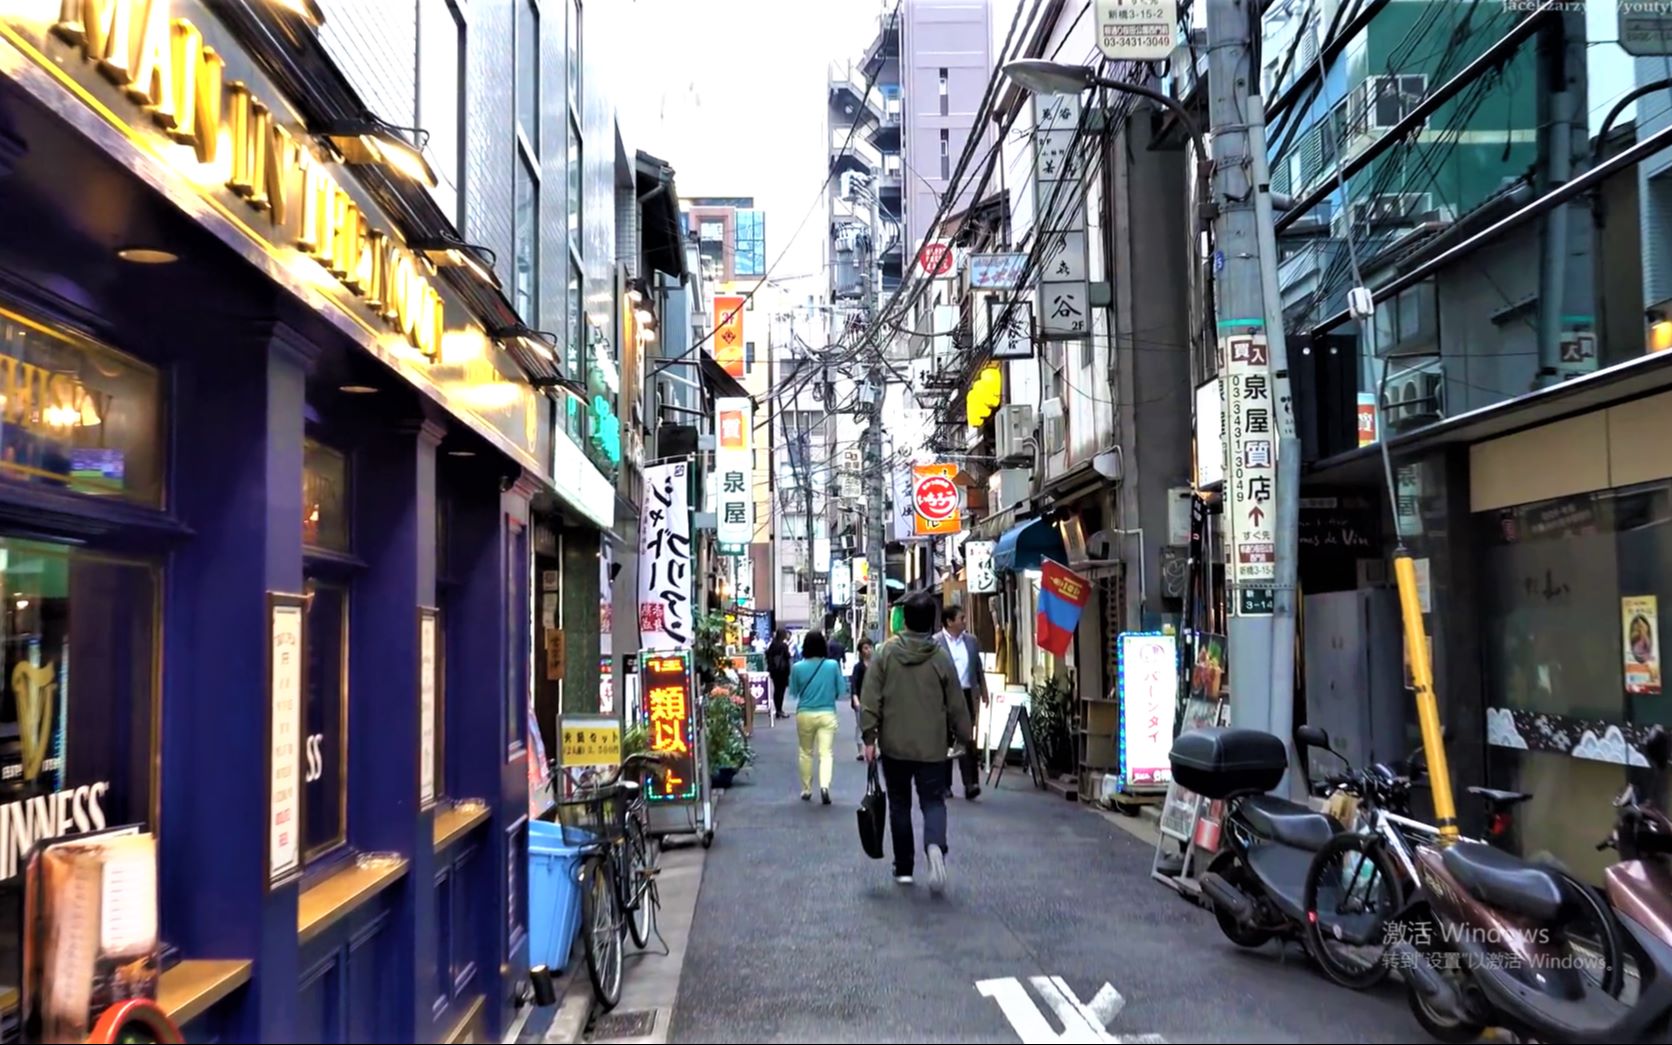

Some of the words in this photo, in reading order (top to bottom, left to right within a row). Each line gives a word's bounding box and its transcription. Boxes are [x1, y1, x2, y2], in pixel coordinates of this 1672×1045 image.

[1104, 37, 1170, 47] 03-3431-3049
[1072, 321, 1084, 330] 2F
[723, 471, 746, 524] 泉屋
